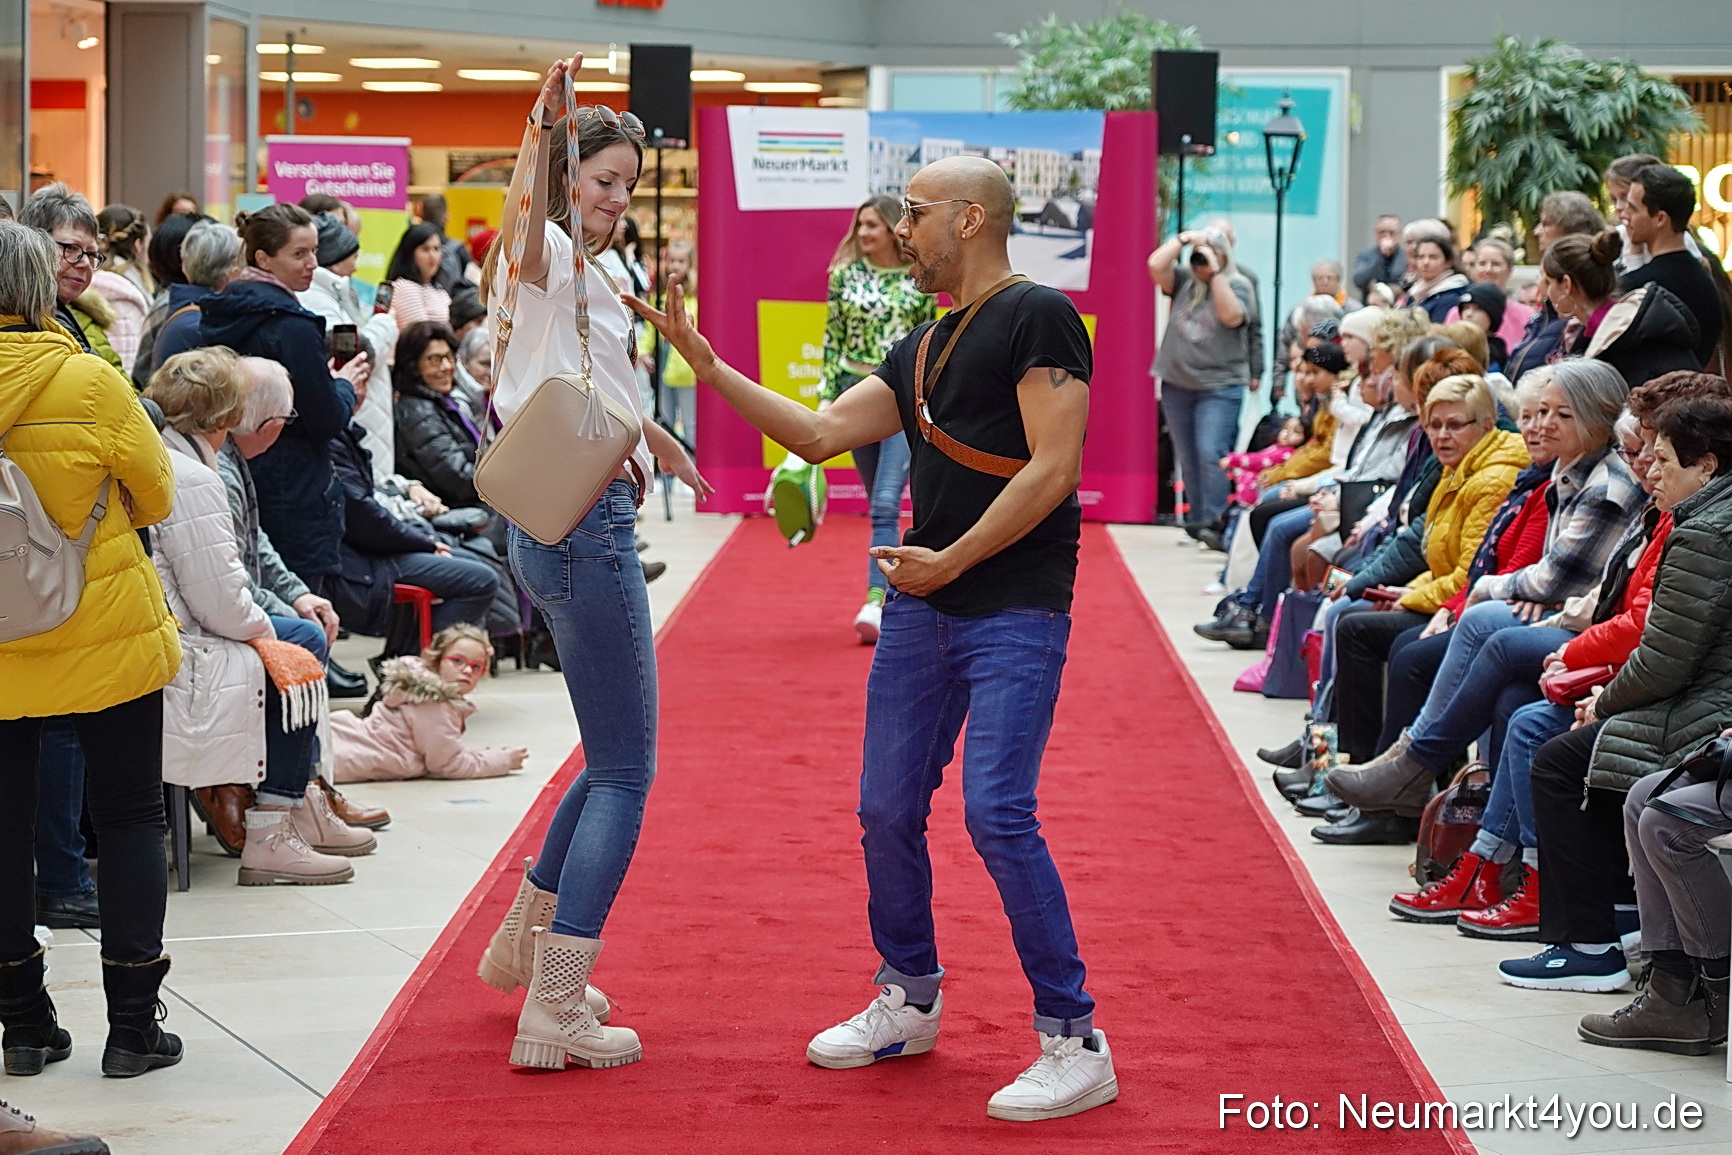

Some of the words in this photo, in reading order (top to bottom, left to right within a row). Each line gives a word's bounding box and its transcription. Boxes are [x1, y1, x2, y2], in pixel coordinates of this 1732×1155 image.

[274, 161, 370, 178] Verschenken
[370, 162, 396, 180] Sie
[753, 158, 848, 171] NeuerMarkt
[305, 179, 396, 197] Gutscheine!
